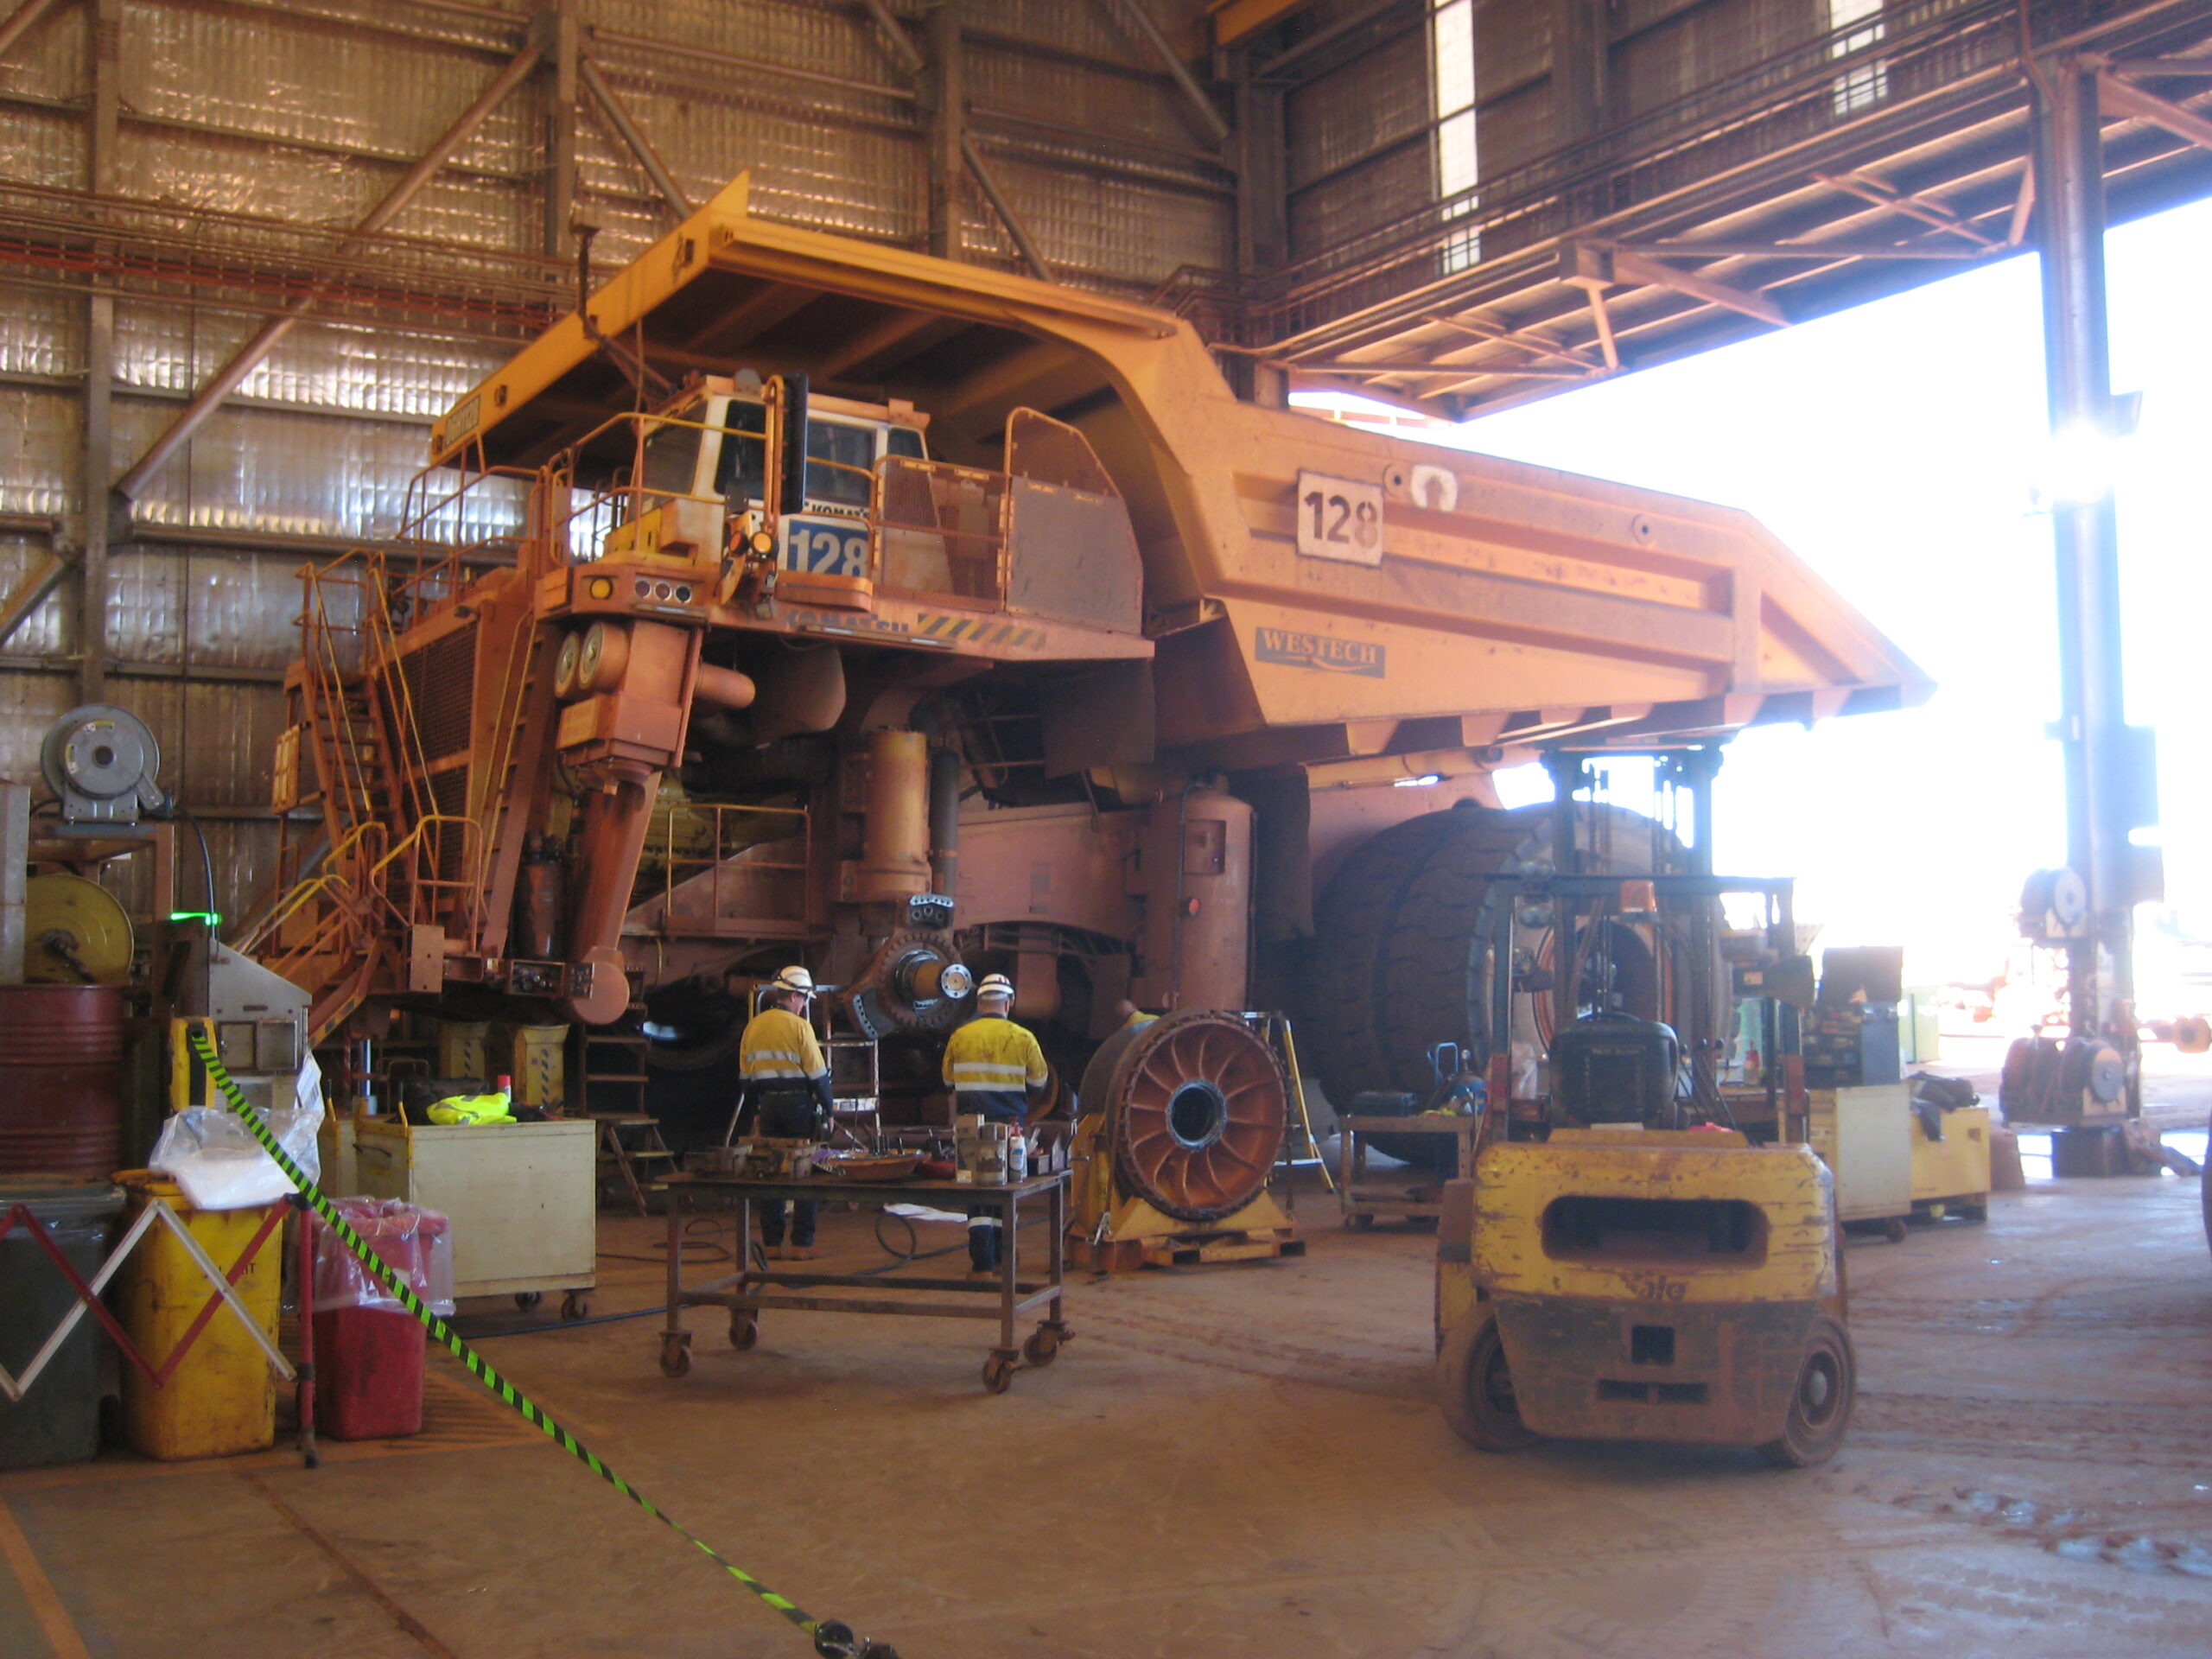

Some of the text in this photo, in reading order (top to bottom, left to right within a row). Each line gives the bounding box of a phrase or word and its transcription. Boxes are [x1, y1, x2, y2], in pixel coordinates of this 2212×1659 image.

[810, 503, 872, 519] KOMATS
[1304, 491, 1378, 549] 128
[790, 528, 868, 577] 128
[1263, 629, 1376, 664] WESTECH
